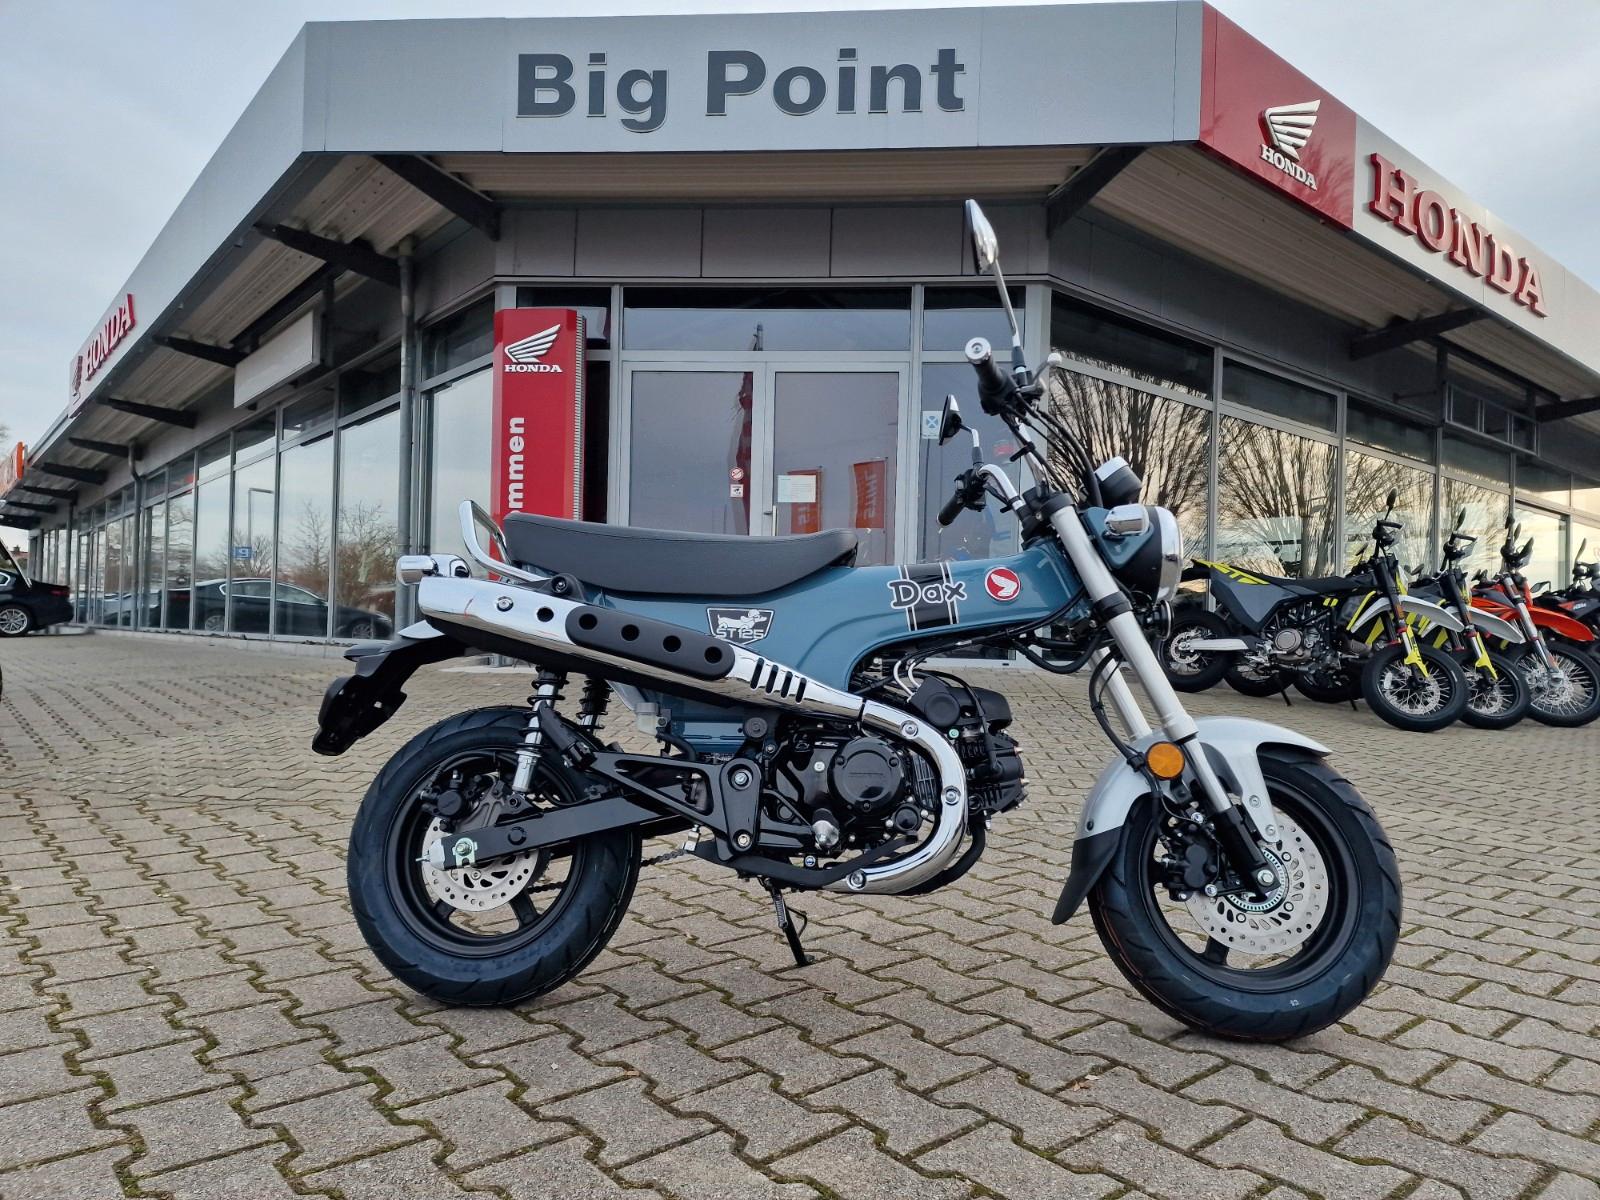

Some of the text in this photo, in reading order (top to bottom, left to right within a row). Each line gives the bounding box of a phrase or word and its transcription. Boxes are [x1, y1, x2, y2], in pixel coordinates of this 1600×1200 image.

[516, 47, 967, 134] Big Point
[1260, 143, 1317, 191] HONDA
[1368, 152, 1548, 318] HONDA
[86, 293, 136, 381] HONDA
[504, 364, 563, 373] HONDA
[508, 416, 525, 514] mmen
[887, 579, 968, 609] Dax
[716, 627, 765, 639] ST125
